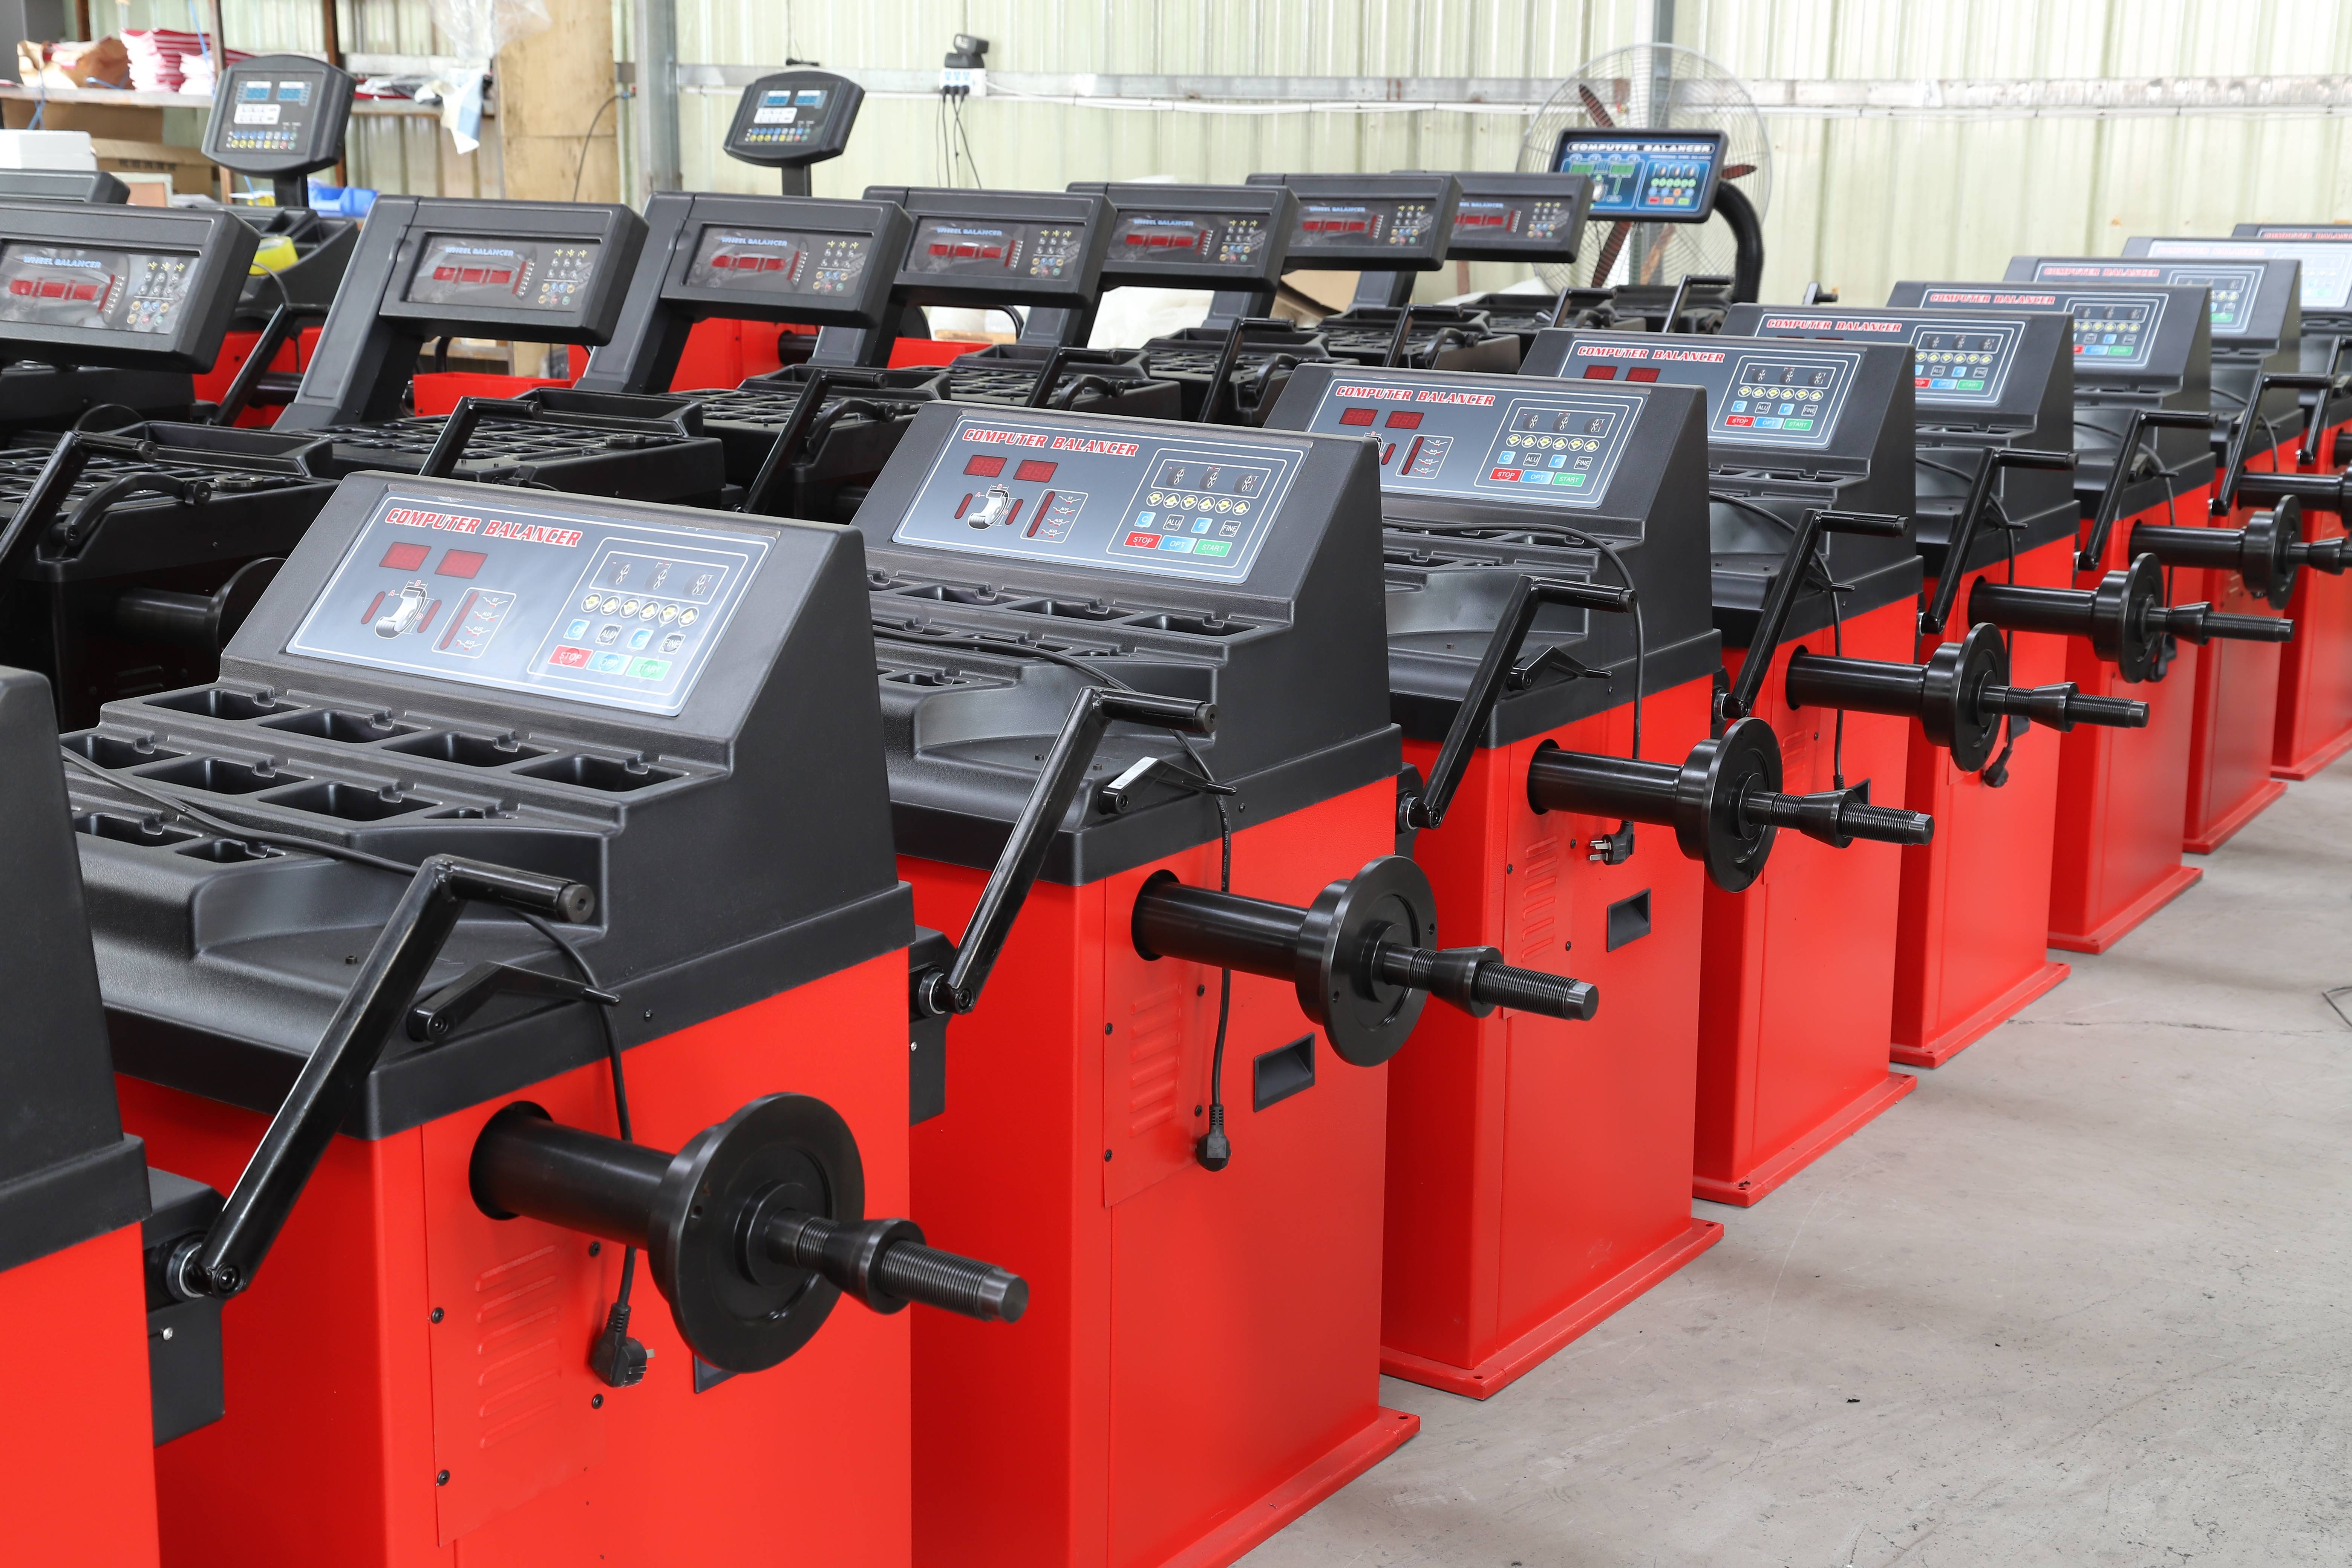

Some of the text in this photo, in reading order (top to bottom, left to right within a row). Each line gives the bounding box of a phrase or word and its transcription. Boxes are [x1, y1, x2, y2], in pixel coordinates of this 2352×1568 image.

[747, 238, 787, 246] BALANCER
[472, 247, 513, 256] BALANCER
[23, 256, 101, 268] WHEEL BALANCER
[1930, 293, 2056, 305] COMPUTER BALANCER
[1766, 319, 1902, 332] COMPUTER BALANCER
[1577, 346, 1725, 363] COMPUTER BALANCER
[1335, 386, 1496, 406] COMPUTER BALANCER
[962, 428, 1139, 457] COMPUTER BALANCER
[385, 508, 583, 548] COMPUTER BALANCER
[1201, 544, 1225, 552] START
[600, 629, 618, 639] ALU
[635, 634, 645, 643] F
[663, 638, 681, 649] FINE
[559, 652, 582, 662] STOP
[599, 658, 619, 668] OPT
[635, 664, 662, 674] START
